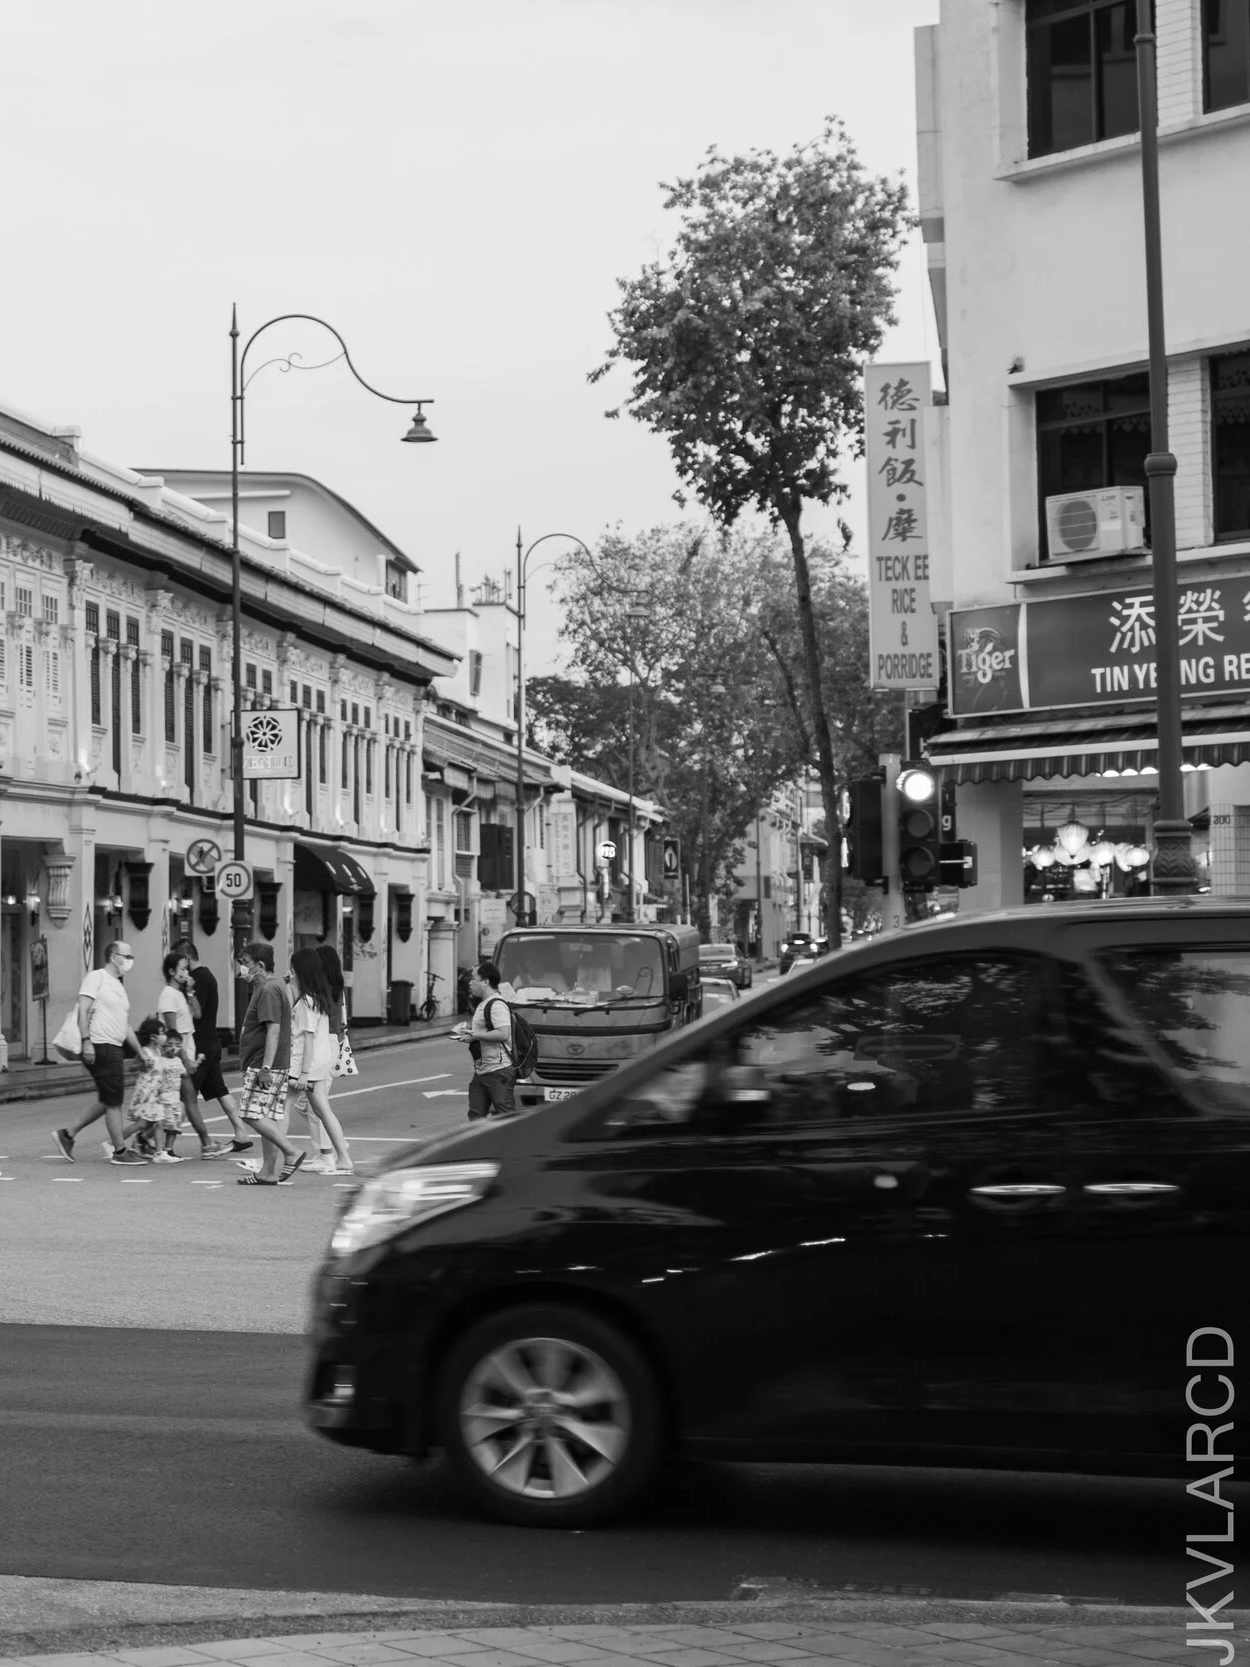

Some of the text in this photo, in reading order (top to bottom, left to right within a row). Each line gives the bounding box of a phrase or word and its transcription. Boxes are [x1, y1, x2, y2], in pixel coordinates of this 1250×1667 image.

[876, 554, 930, 581] TECK EE
[892, 587, 916, 614] RICE
[901, 620, 909, 647] &
[1109, 588, 1250, 654] 添榮
[877, 652, 933, 680] PORRIDGE
[957, 643, 1015, 684] Tiger
[1091, 665, 1129, 693] TIN
[1133, 656, 1215, 690] YENG
[1213, 814, 1231, 825] 300
[226, 873, 242, 888] 50
